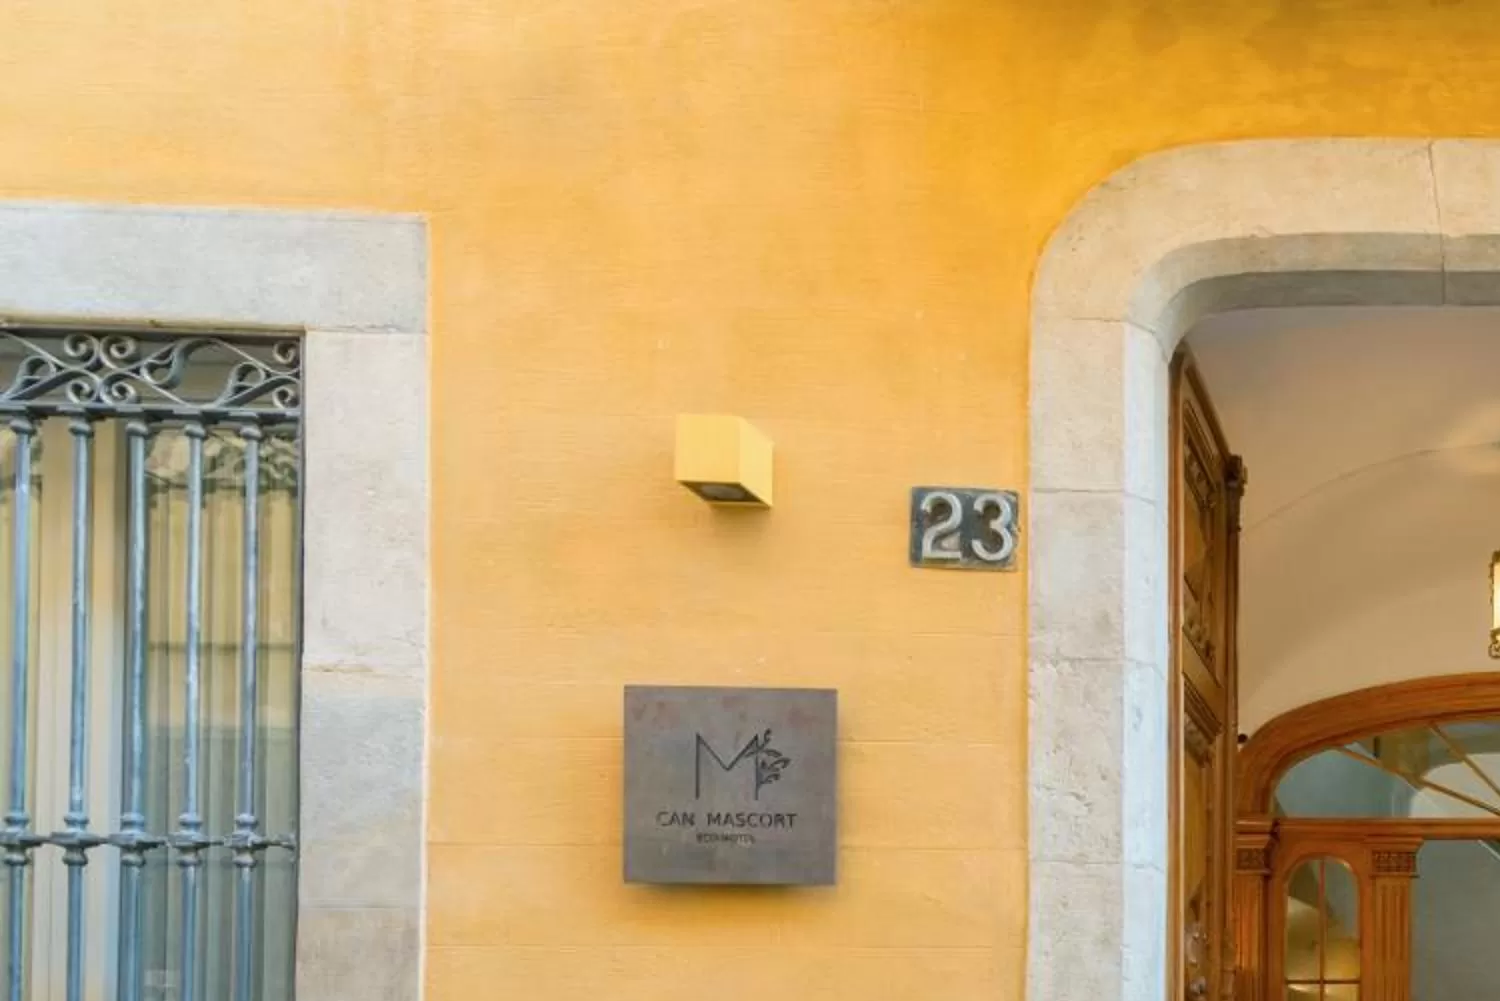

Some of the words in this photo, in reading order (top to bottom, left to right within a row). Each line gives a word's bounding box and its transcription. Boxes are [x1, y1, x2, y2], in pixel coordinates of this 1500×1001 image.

[920, 491, 1013, 561] 23
[656, 811, 696, 827] CAN
[706, 811, 798, 829] MASCORT
